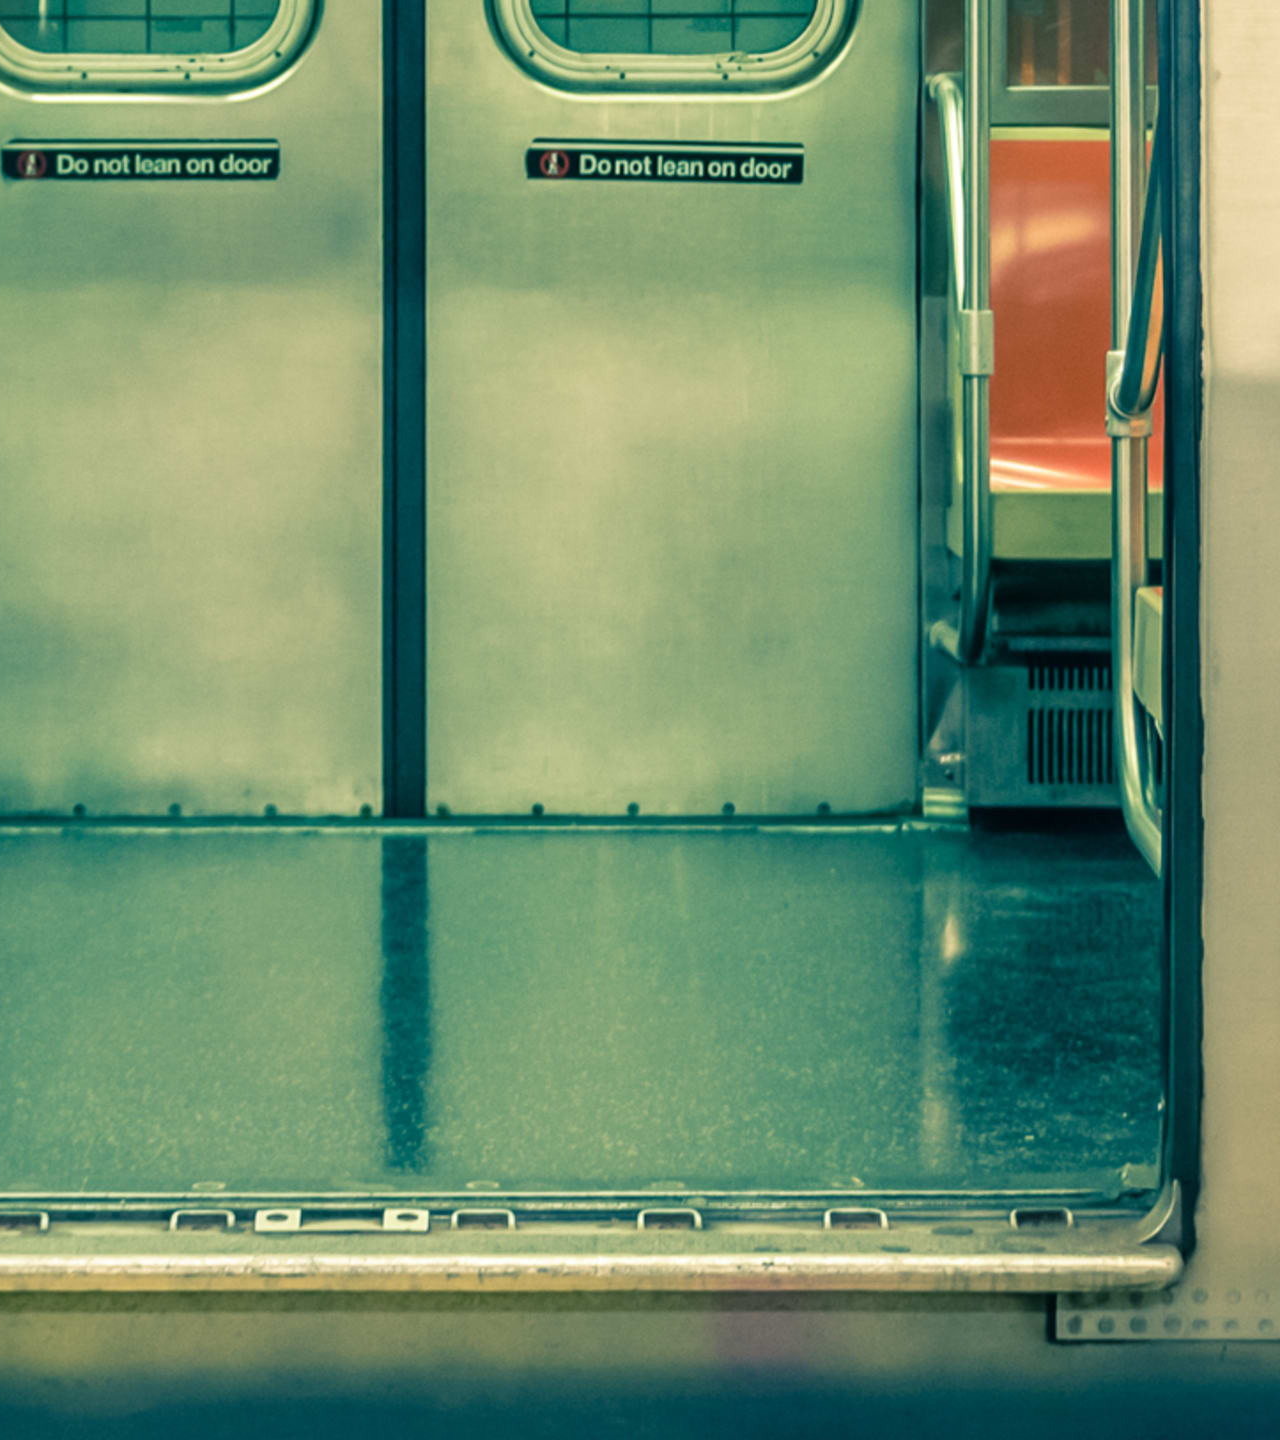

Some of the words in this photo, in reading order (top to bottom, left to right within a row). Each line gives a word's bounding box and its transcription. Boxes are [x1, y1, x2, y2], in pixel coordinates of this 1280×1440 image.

[57, 155, 88, 174] Do
[94, 156, 131, 174] not
[136, 154, 180, 174] lean
[186, 158, 214, 174] on
[219, 154, 272, 174] door
[580, 155, 611, 175] Do
[616, 156, 651, 176] not
[657, 156, 703, 177] lean
[708, 161, 733, 178] on
[740, 157, 792, 179] door
